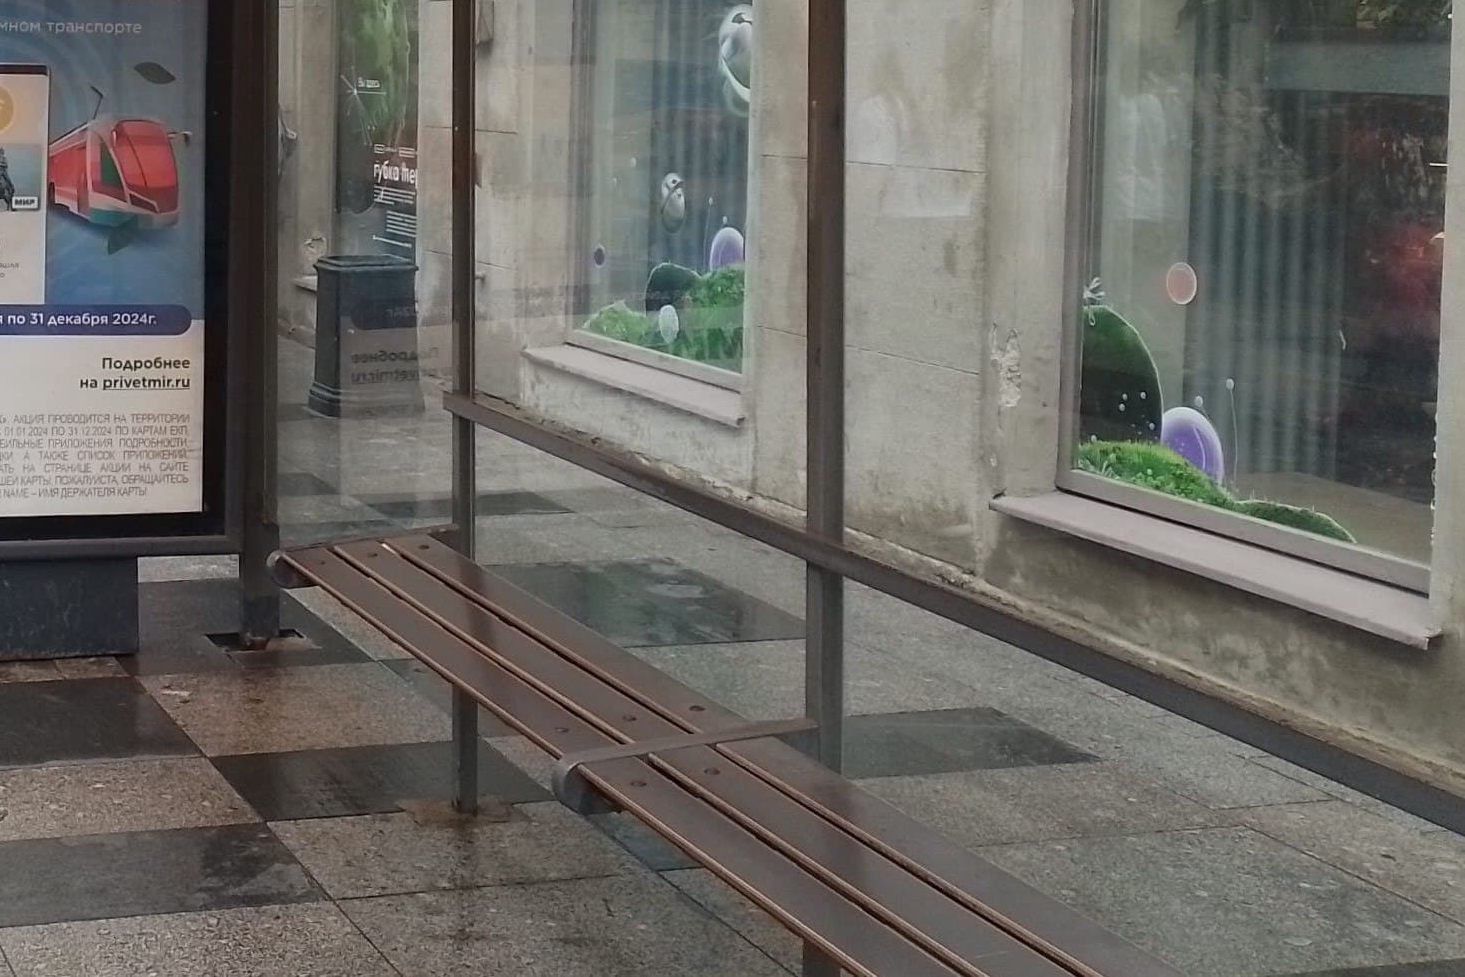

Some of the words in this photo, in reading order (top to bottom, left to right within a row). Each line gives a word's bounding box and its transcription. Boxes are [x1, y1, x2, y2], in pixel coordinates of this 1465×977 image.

[47, 21, 142, 37] транспорте
[8, 314, 25, 325] по
[30, 312, 44, 325] 31
[48, 312, 108, 328] декабря
[112, 312, 157, 326] 2024г.
[102, 357, 191, 372] Подробнее
[80, 377, 98, 389] на
[102, 375, 191, 392] privetmir.ru
